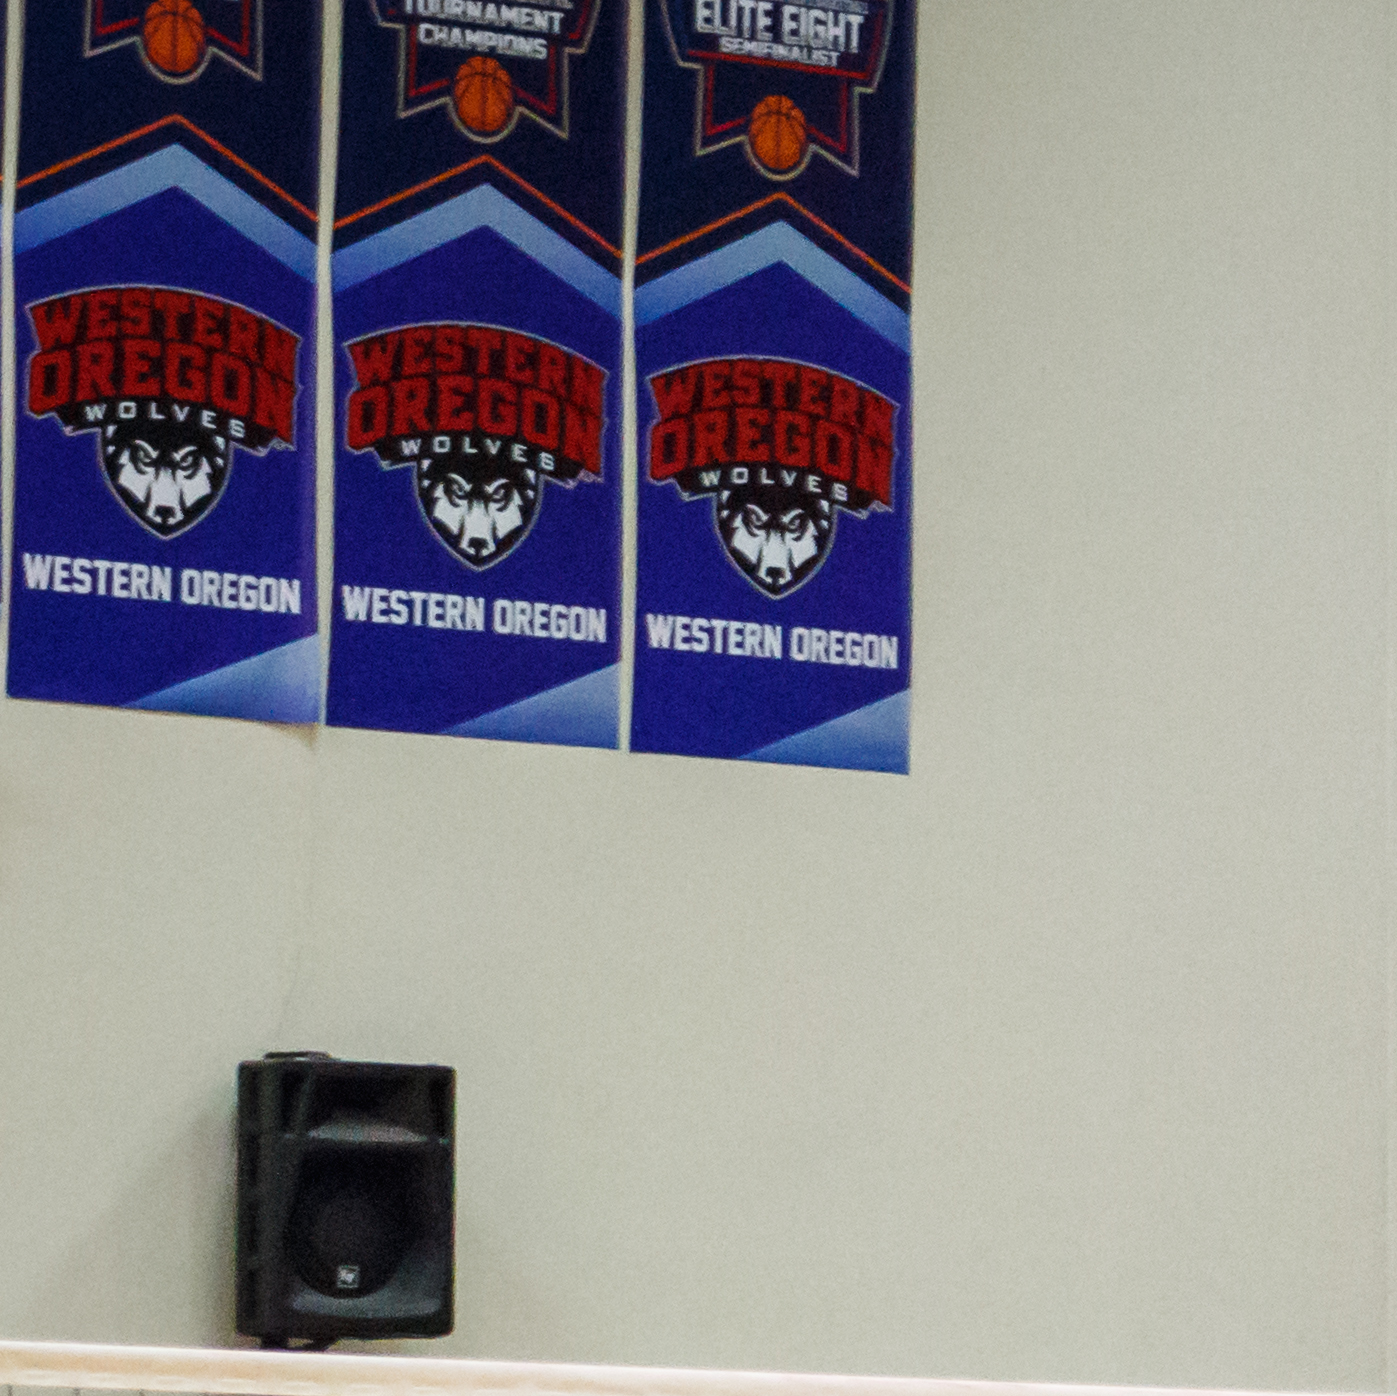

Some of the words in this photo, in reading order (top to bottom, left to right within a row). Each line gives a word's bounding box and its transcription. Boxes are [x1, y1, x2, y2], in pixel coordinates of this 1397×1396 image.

[417, 22, 548, 60] CHAMPIONS
[695, 0, 774, 42] ELITE
[781, 4, 864, 53] EIGHT
[31, 288, 298, 384] WESTERN
[28, 338, 295, 442] OREGON
[351, 326, 605, 417] WESTERN
[85, 401, 246, 438] WOLVES
[348, 375, 601, 474] OREGON
[651, 359, 894, 447] WESTERN
[401, 436, 555, 471] WOLVES
[650, 407, 891, 505] OREGON
[700, 467, 848, 501] WOLVES
[23, 552, 172, 601] WESTERN
[180, 568, 301, 614] OREGON
[341, 585, 485, 631] WESTERN
[493, 599, 607, 642] OREGON
[646, 613, 782, 659] WESTERN
[790, 626, 898, 669] OREGON
